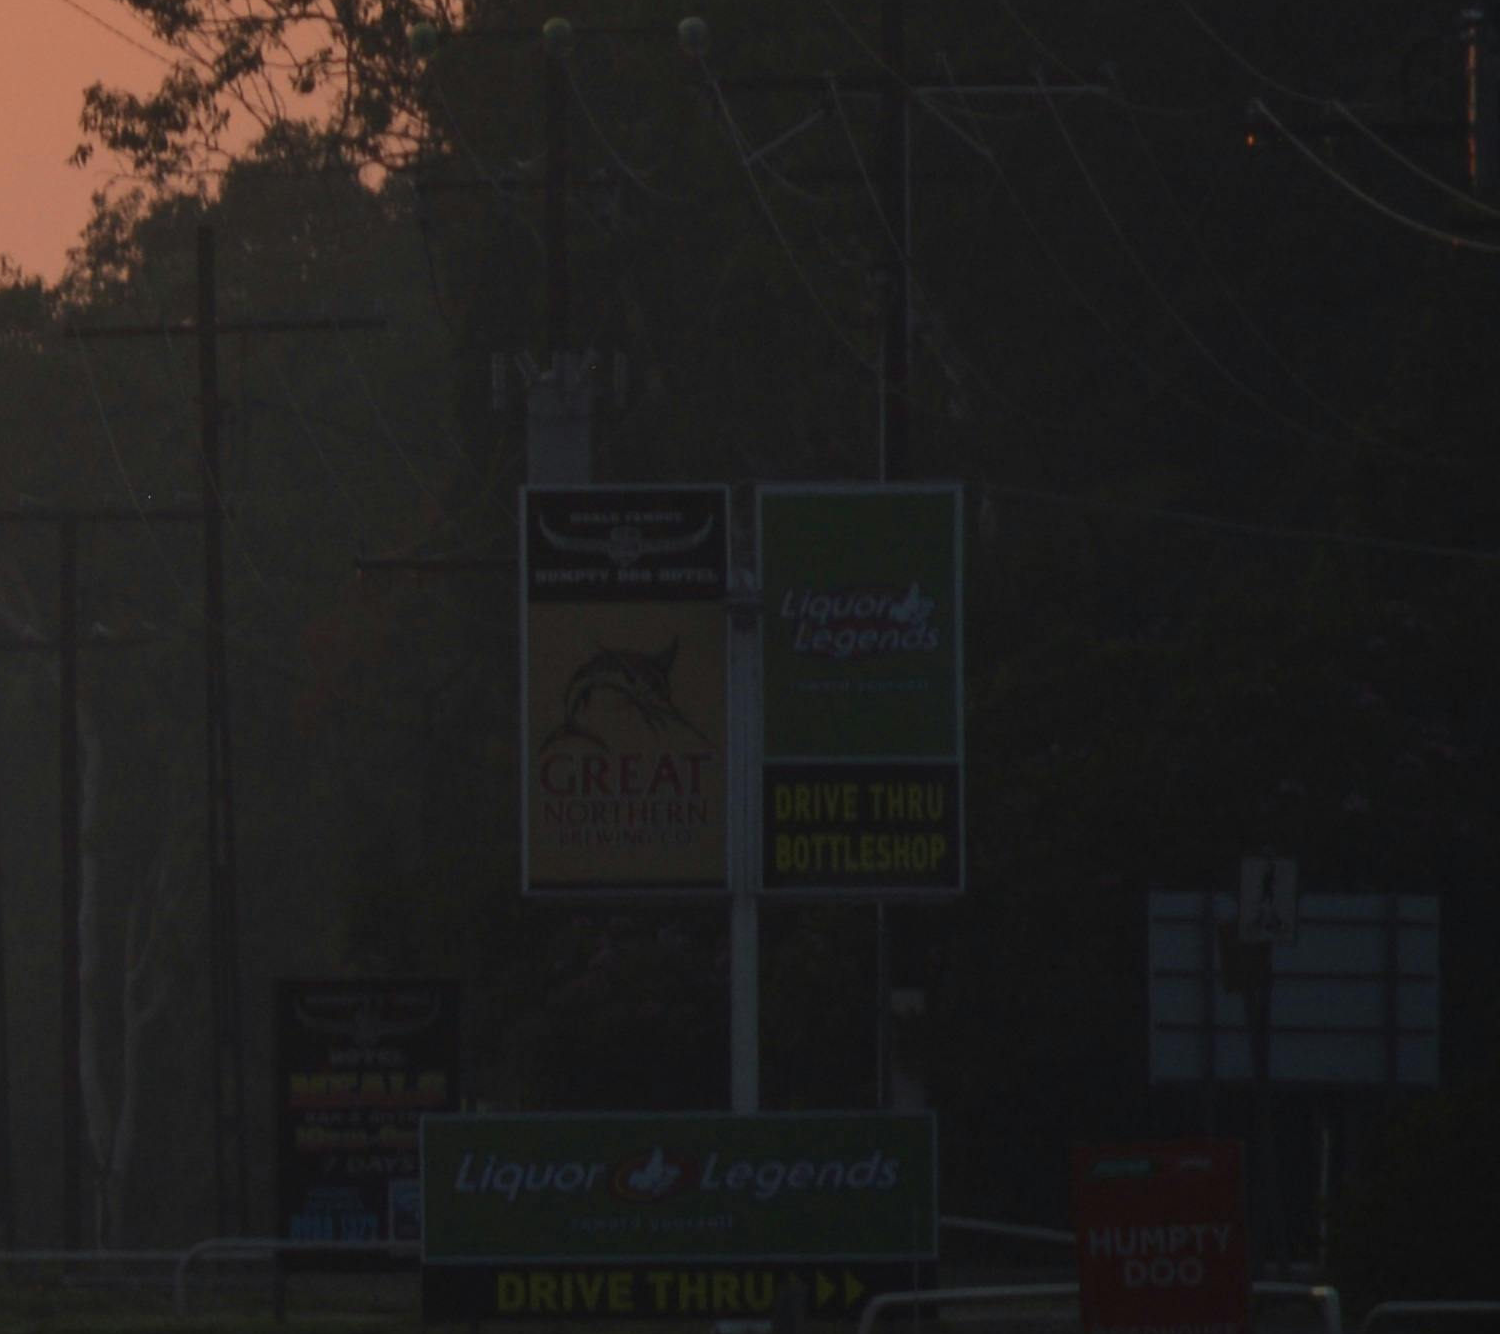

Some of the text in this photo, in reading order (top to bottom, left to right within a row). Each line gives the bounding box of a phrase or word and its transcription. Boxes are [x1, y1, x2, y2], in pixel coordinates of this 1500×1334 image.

[536, 569, 610, 584] HUMPTY
[657, 569, 717, 584] HOTEL
[780, 587, 894, 624] Liquor
[793, 619, 940, 660] Legends
[540, 751, 715, 795] GREAT
[543, 799, 708, 825] NORTHERN
[774, 782, 944, 822] DRIVE THRU
[775, 833, 947, 873] BOTTLESHOP
[289, 1071, 448, 1108] MEALS
[454, 1147, 902, 1203] Liquor Legends
[1087, 1223, 1231, 1259] HUMPTY
[495, 1271, 774, 1311] DRIVE THRU
[1124, 1257, 1205, 1289] DOO
